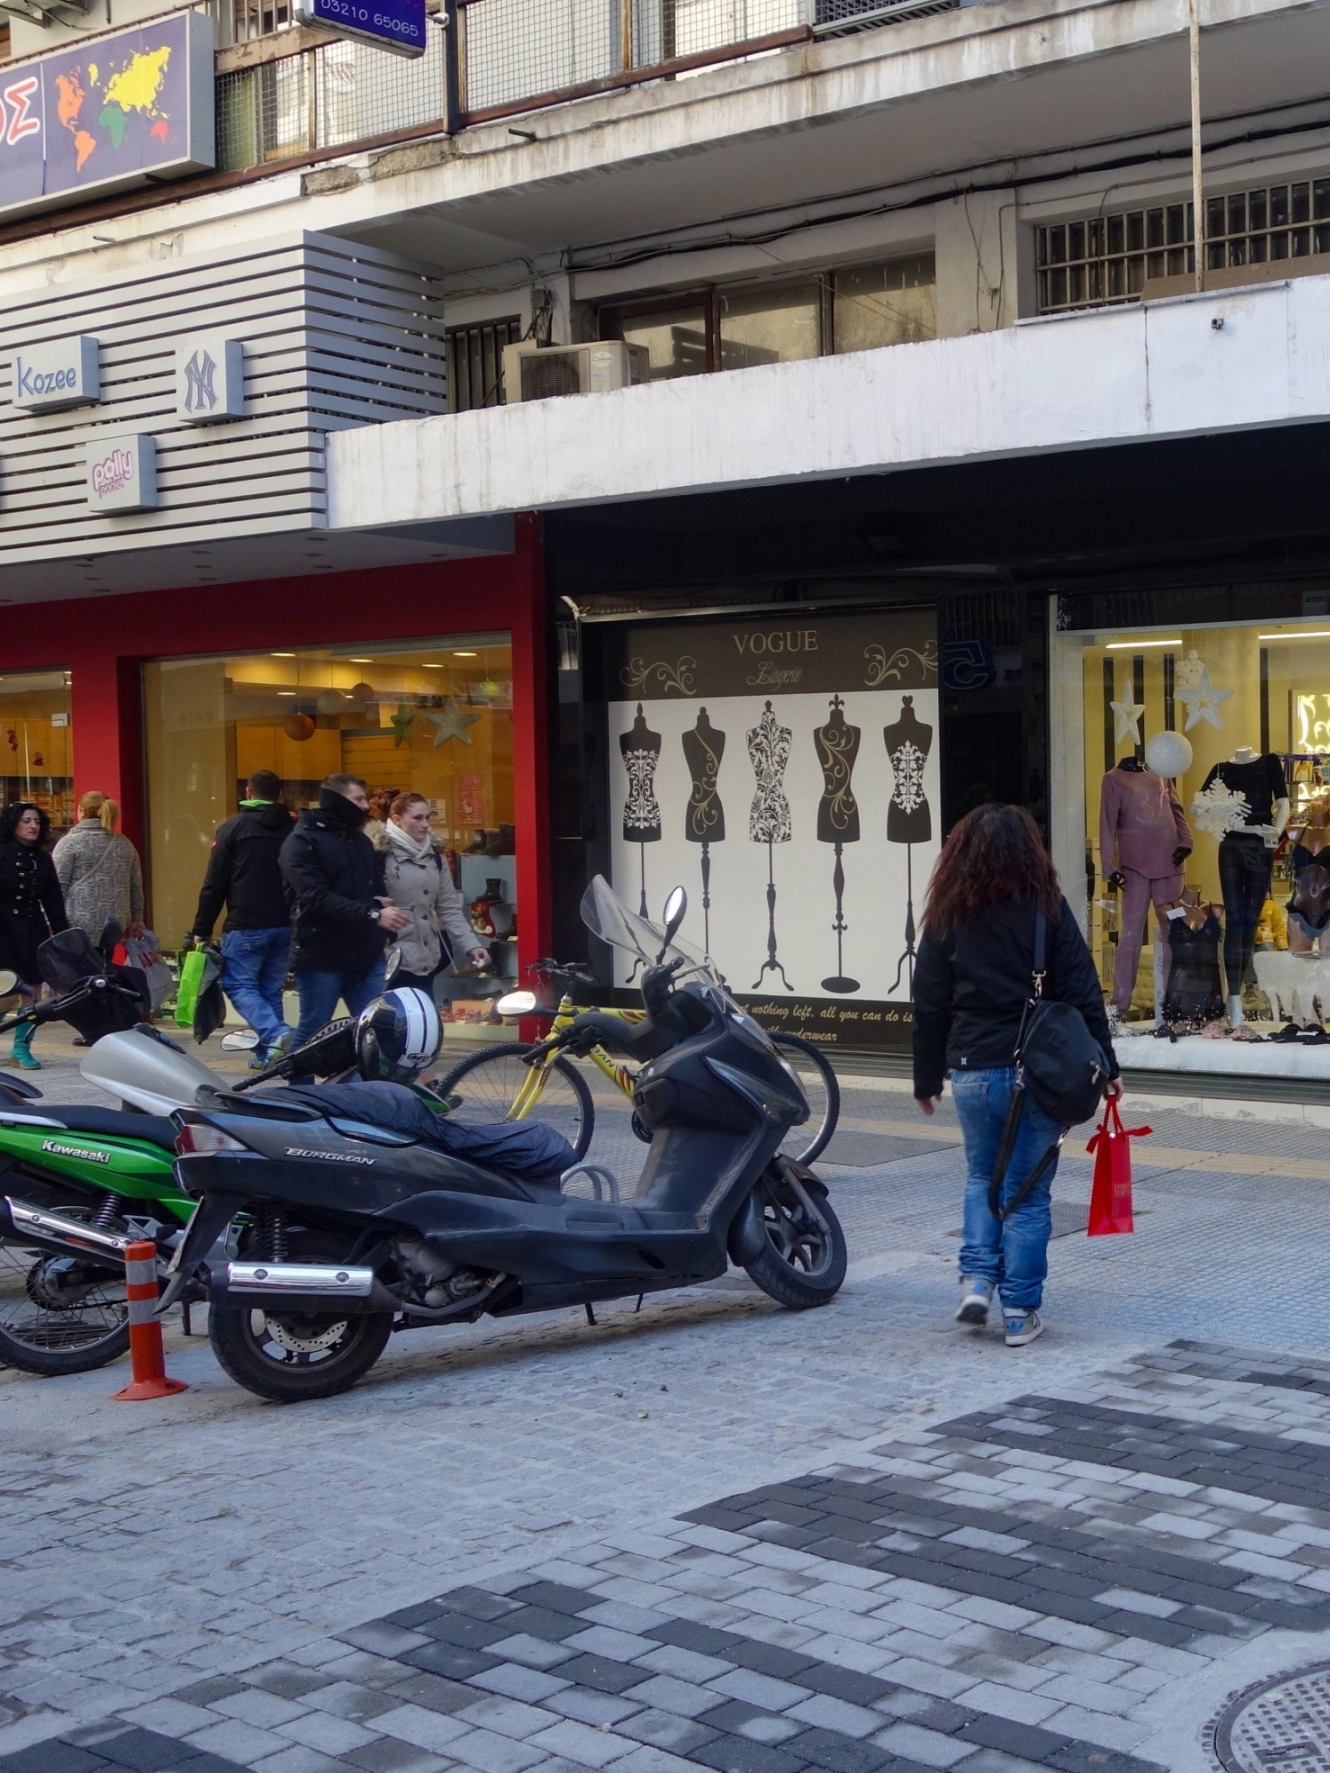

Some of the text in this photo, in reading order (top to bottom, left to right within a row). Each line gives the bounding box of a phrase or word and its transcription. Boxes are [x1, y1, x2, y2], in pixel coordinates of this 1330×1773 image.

[321, 0, 419, 36] 03210 65065
[0, 76, 40, 145] Σ
[732, 630, 819, 655] VOGUE
[745, 661, 803, 692] Lingerie
[751, 1002, 790, 1020] nothing
[820, 1006, 837, 1019] all
[839, 1010, 859, 1023] you
[862, 1011, 882, 1022] can
[885, 1009, 899, 1022] do
[902, 1012, 914, 1023] is
[42, 1140, 111, 1163] Kawasaki
[284, 1146, 378, 1165] BURGMAN
